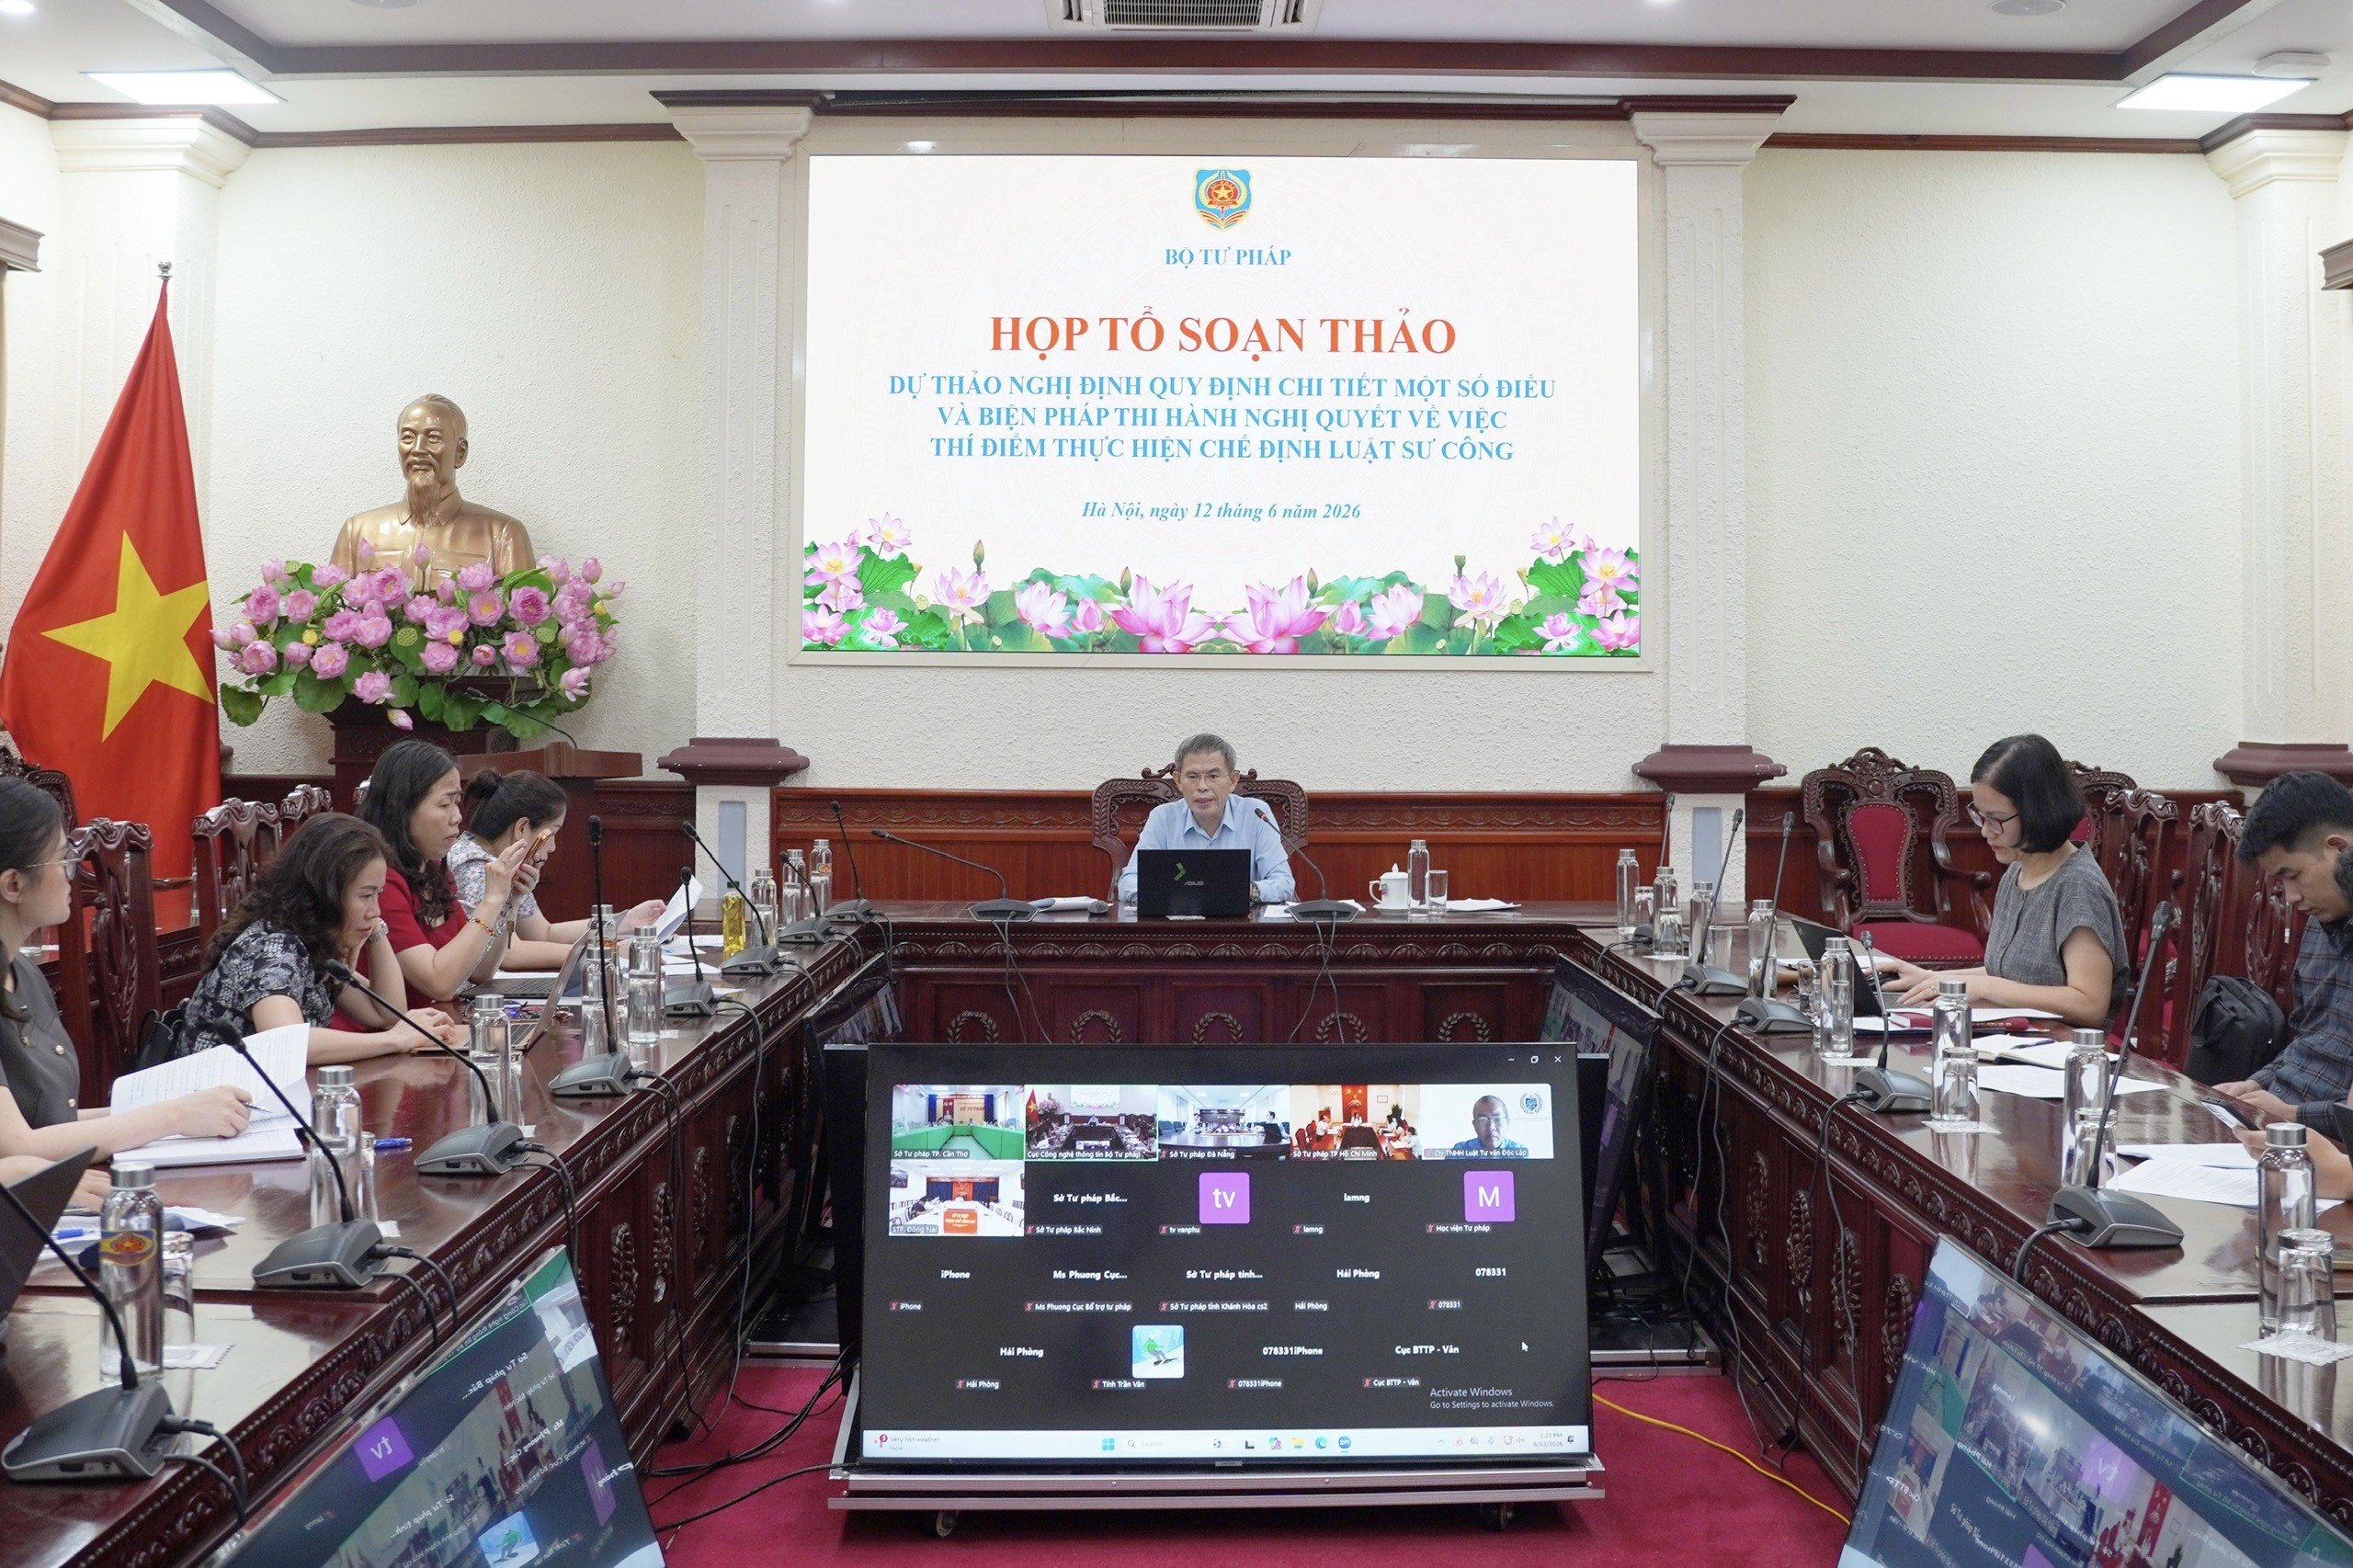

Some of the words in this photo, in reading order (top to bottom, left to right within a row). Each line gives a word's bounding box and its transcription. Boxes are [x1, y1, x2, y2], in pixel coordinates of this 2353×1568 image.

[1165, 246, 1195, 269] BỘ
[1200, 248, 1232, 266] TƯ
[1236, 244, 1291, 266] PHÁP
[990, 316, 1089, 361] HỌP
[1098, 306, 1165, 352] TỔ
[1178, 317, 1304, 362] SOẠN
[1319, 308, 1457, 354] THẢO
[889, 373, 926, 399] DỰ
[931, 370, 1002, 395] THẢO
[1009, 375, 1072, 399] NGHỊ
[1079, 376, 1142, 400] ĐỊNH
[1148, 376, 1203, 400] QUY
[1209, 376, 1271, 401] ĐỊNH
[1278, 377, 1324, 397] CHI
[1330, 372, 1388, 397] TIẾT
[1394, 375, 1451, 402] MỘT
[1457, 373, 1490, 398] SỐ
[1496, 374, 1556, 398] ĐIỀU
[938, 403, 973, 426] VÀ
[979, 403, 1037, 429] BIỆN
[1044, 403, 1109, 426] PHÁP
[1114, 407, 1157, 426] THI
[1165, 403, 1238, 427] HÀNH
[1245, 408, 1309, 432] NGHỊ
[1315, 404, 1403, 432] QUYẾT
[1408, 404, 1440, 429] VỀ
[1448, 407, 1507, 434] VIỆC
[930, 433, 973, 457] THÍ
[981, 432, 1046, 457] ĐIỂM
[1052, 436, 1124, 462] THỰC
[1131, 436, 1192, 462] HIỆN
[1199, 434, 1252, 459] CHẾ
[1258, 439, 1321, 463] ĐỊNH
[1327, 437, 1396, 464] LUẬT
[1402, 437, 1436, 460] SƯ
[1440, 436, 1515, 460] CÔNG
[1081, 501, 1107, 517] Hà
[1111, 501, 1145, 519] Nội,
[1149, 503, 1188, 522] ngày
[1194, 502, 1213, 517] 12
[1216, 501, 1263, 522] tháng
[1267, 503, 1278, 518] 6
[1281, 504, 1317, 519] năm
[1322, 503, 1362, 519] 2026
[1066, 1193, 1079, 1202] Tư
[1080, 1193, 1102, 1204] pháp
[1211, 1187, 1236, 1209] tv
[1343, 1192, 1370, 1203] lamng
[1478, 1186, 1500, 1208] M
[1302, 1225, 1323, 1234] lamng
[940, 1269, 971, 1278] iPhone
[1052, 1270, 1066, 1278] Ms
[1475, 1267, 1506, 1278] 078331
[1438, 1301, 1461, 1309] 078331
[1262, 1346, 1324, 1356] 078331iPhone
[1413, 1346, 1435, 1354] BTTP
[1237, 1380, 1282, 1388] 078331iPhone
[1429, 1388, 1468, 1397] Activate
[1470, 1387, 1513, 1396] Windows
[1452, 1401, 1481, 1410] Settings
[1519, 1400, 1555, 1408] Windows.
